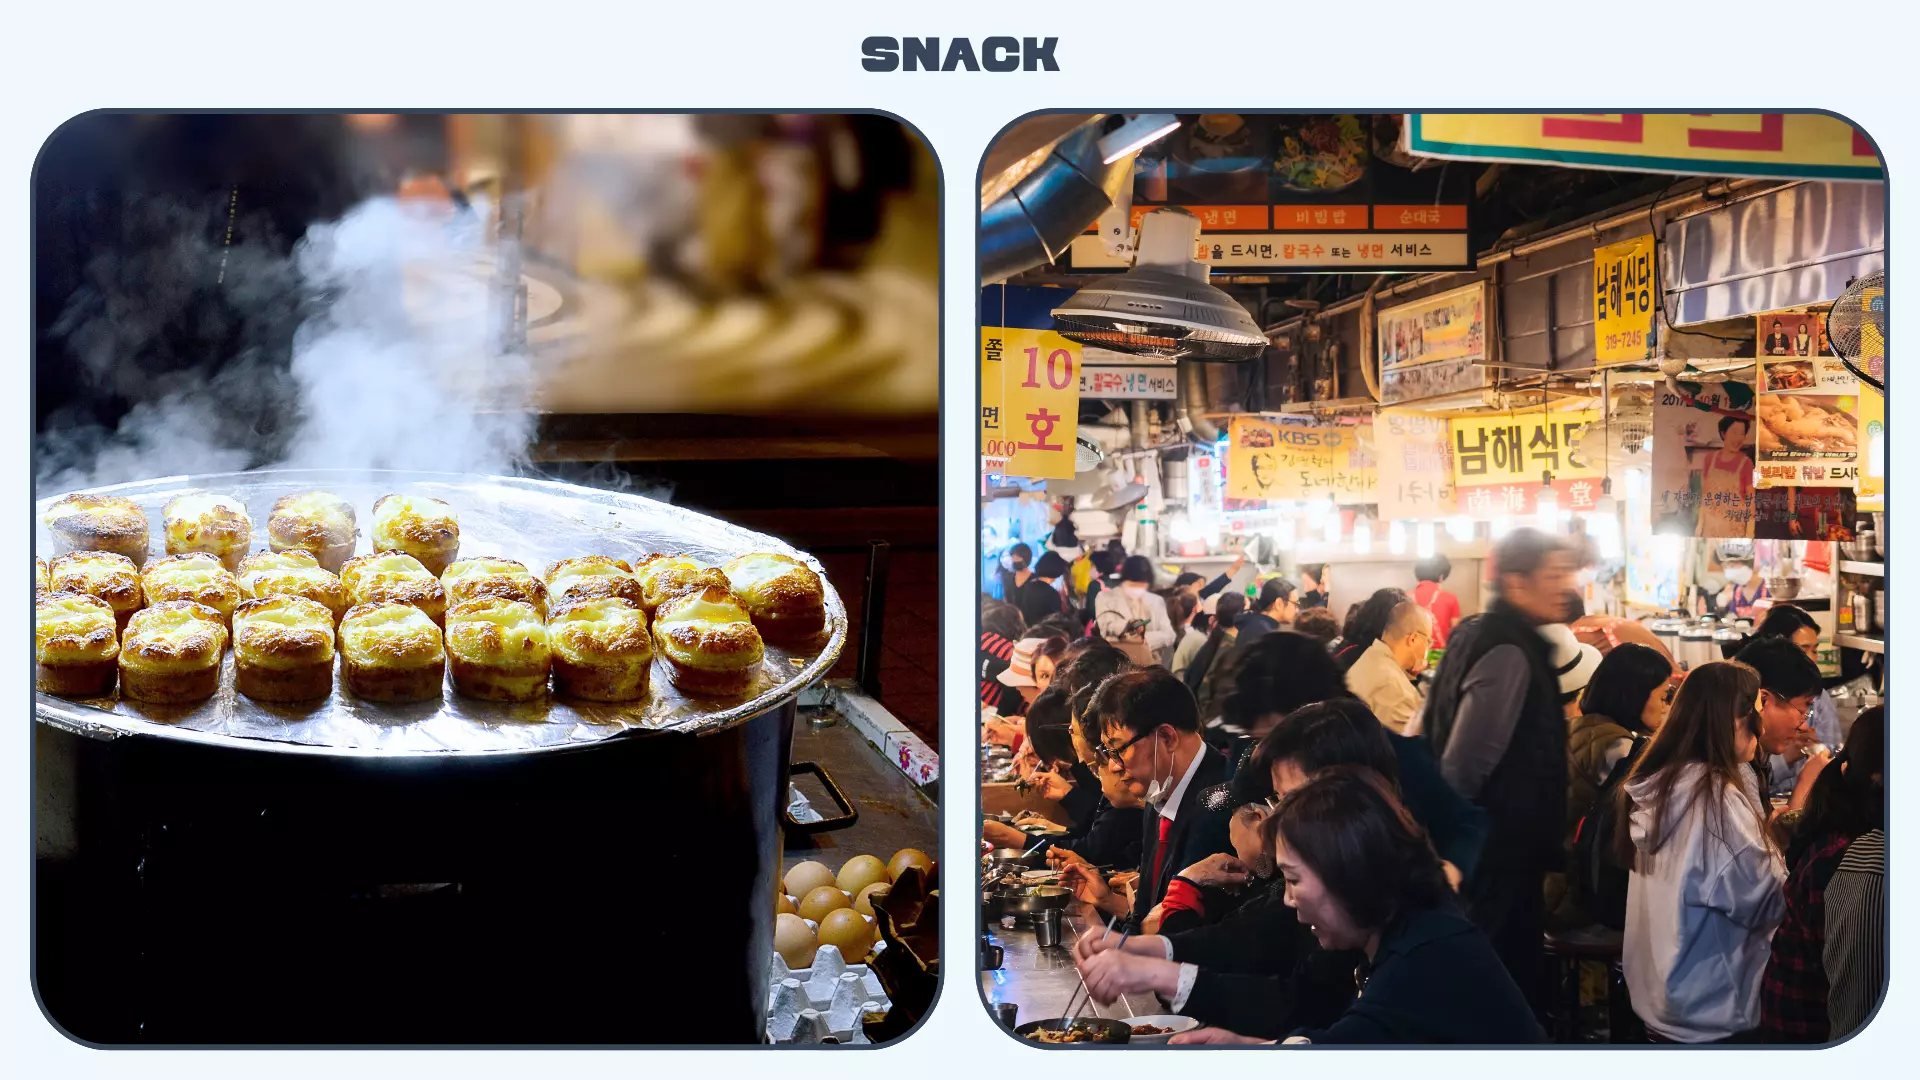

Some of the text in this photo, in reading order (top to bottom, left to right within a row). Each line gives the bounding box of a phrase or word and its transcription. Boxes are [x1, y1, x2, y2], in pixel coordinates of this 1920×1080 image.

[1399, 209, 1441, 225] 순대국
[1230, 243, 1279, 260] 드시면,
[1283, 243, 1325, 260] 칼국수
[1331, 247, 1351, 259] 또는
[1357, 243, 1384, 260] 냉면
[1390, 243, 1432, 257] 서비스
[1597, 252, 1651, 321] 남해식당
[1605, 329, 1642, 351] 319-7245
[1022, 347, 1073, 391] 10
[1017, 407, 1064, 452] 호
[1278, 429, 1321, 447] KBS
[1466, 480, 1594, 514] 南海堂
[1704, 491, 1741, 507] 운영하는
